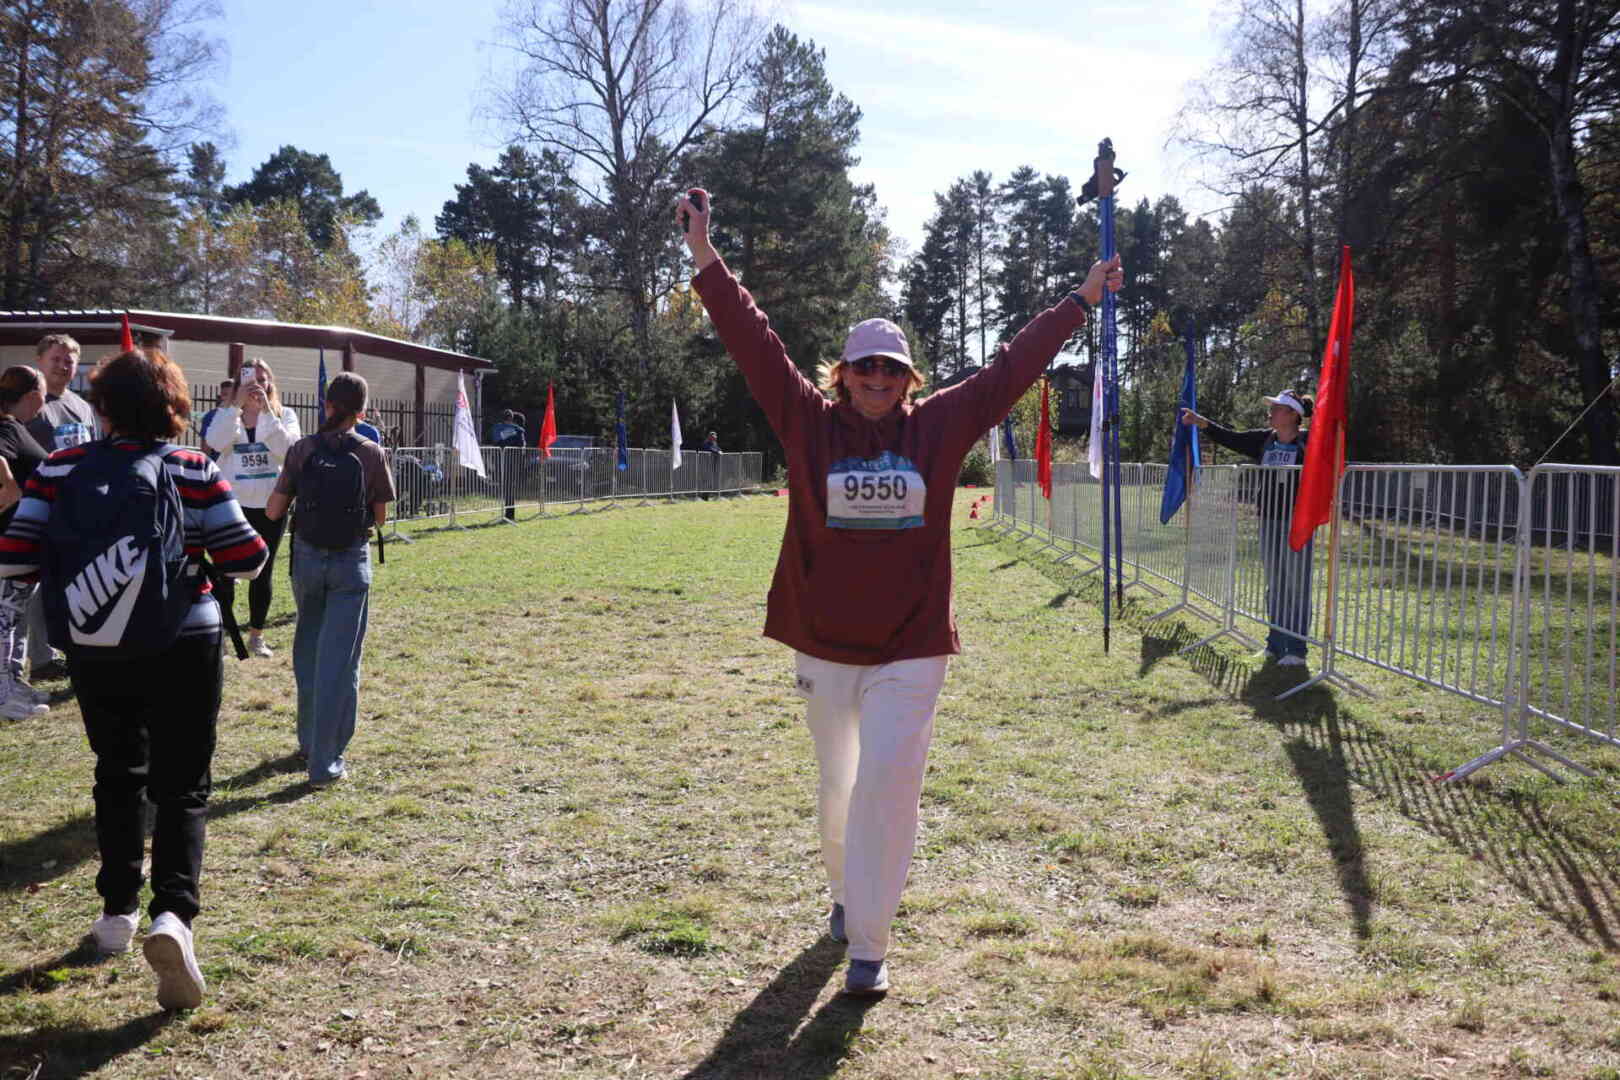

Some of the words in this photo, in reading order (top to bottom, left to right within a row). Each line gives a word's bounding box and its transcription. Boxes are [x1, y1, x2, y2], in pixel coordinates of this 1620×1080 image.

[241, 453, 268, 467] 9594
[844, 475, 907, 501] 9550
[64, 535, 142, 627] NIKE
